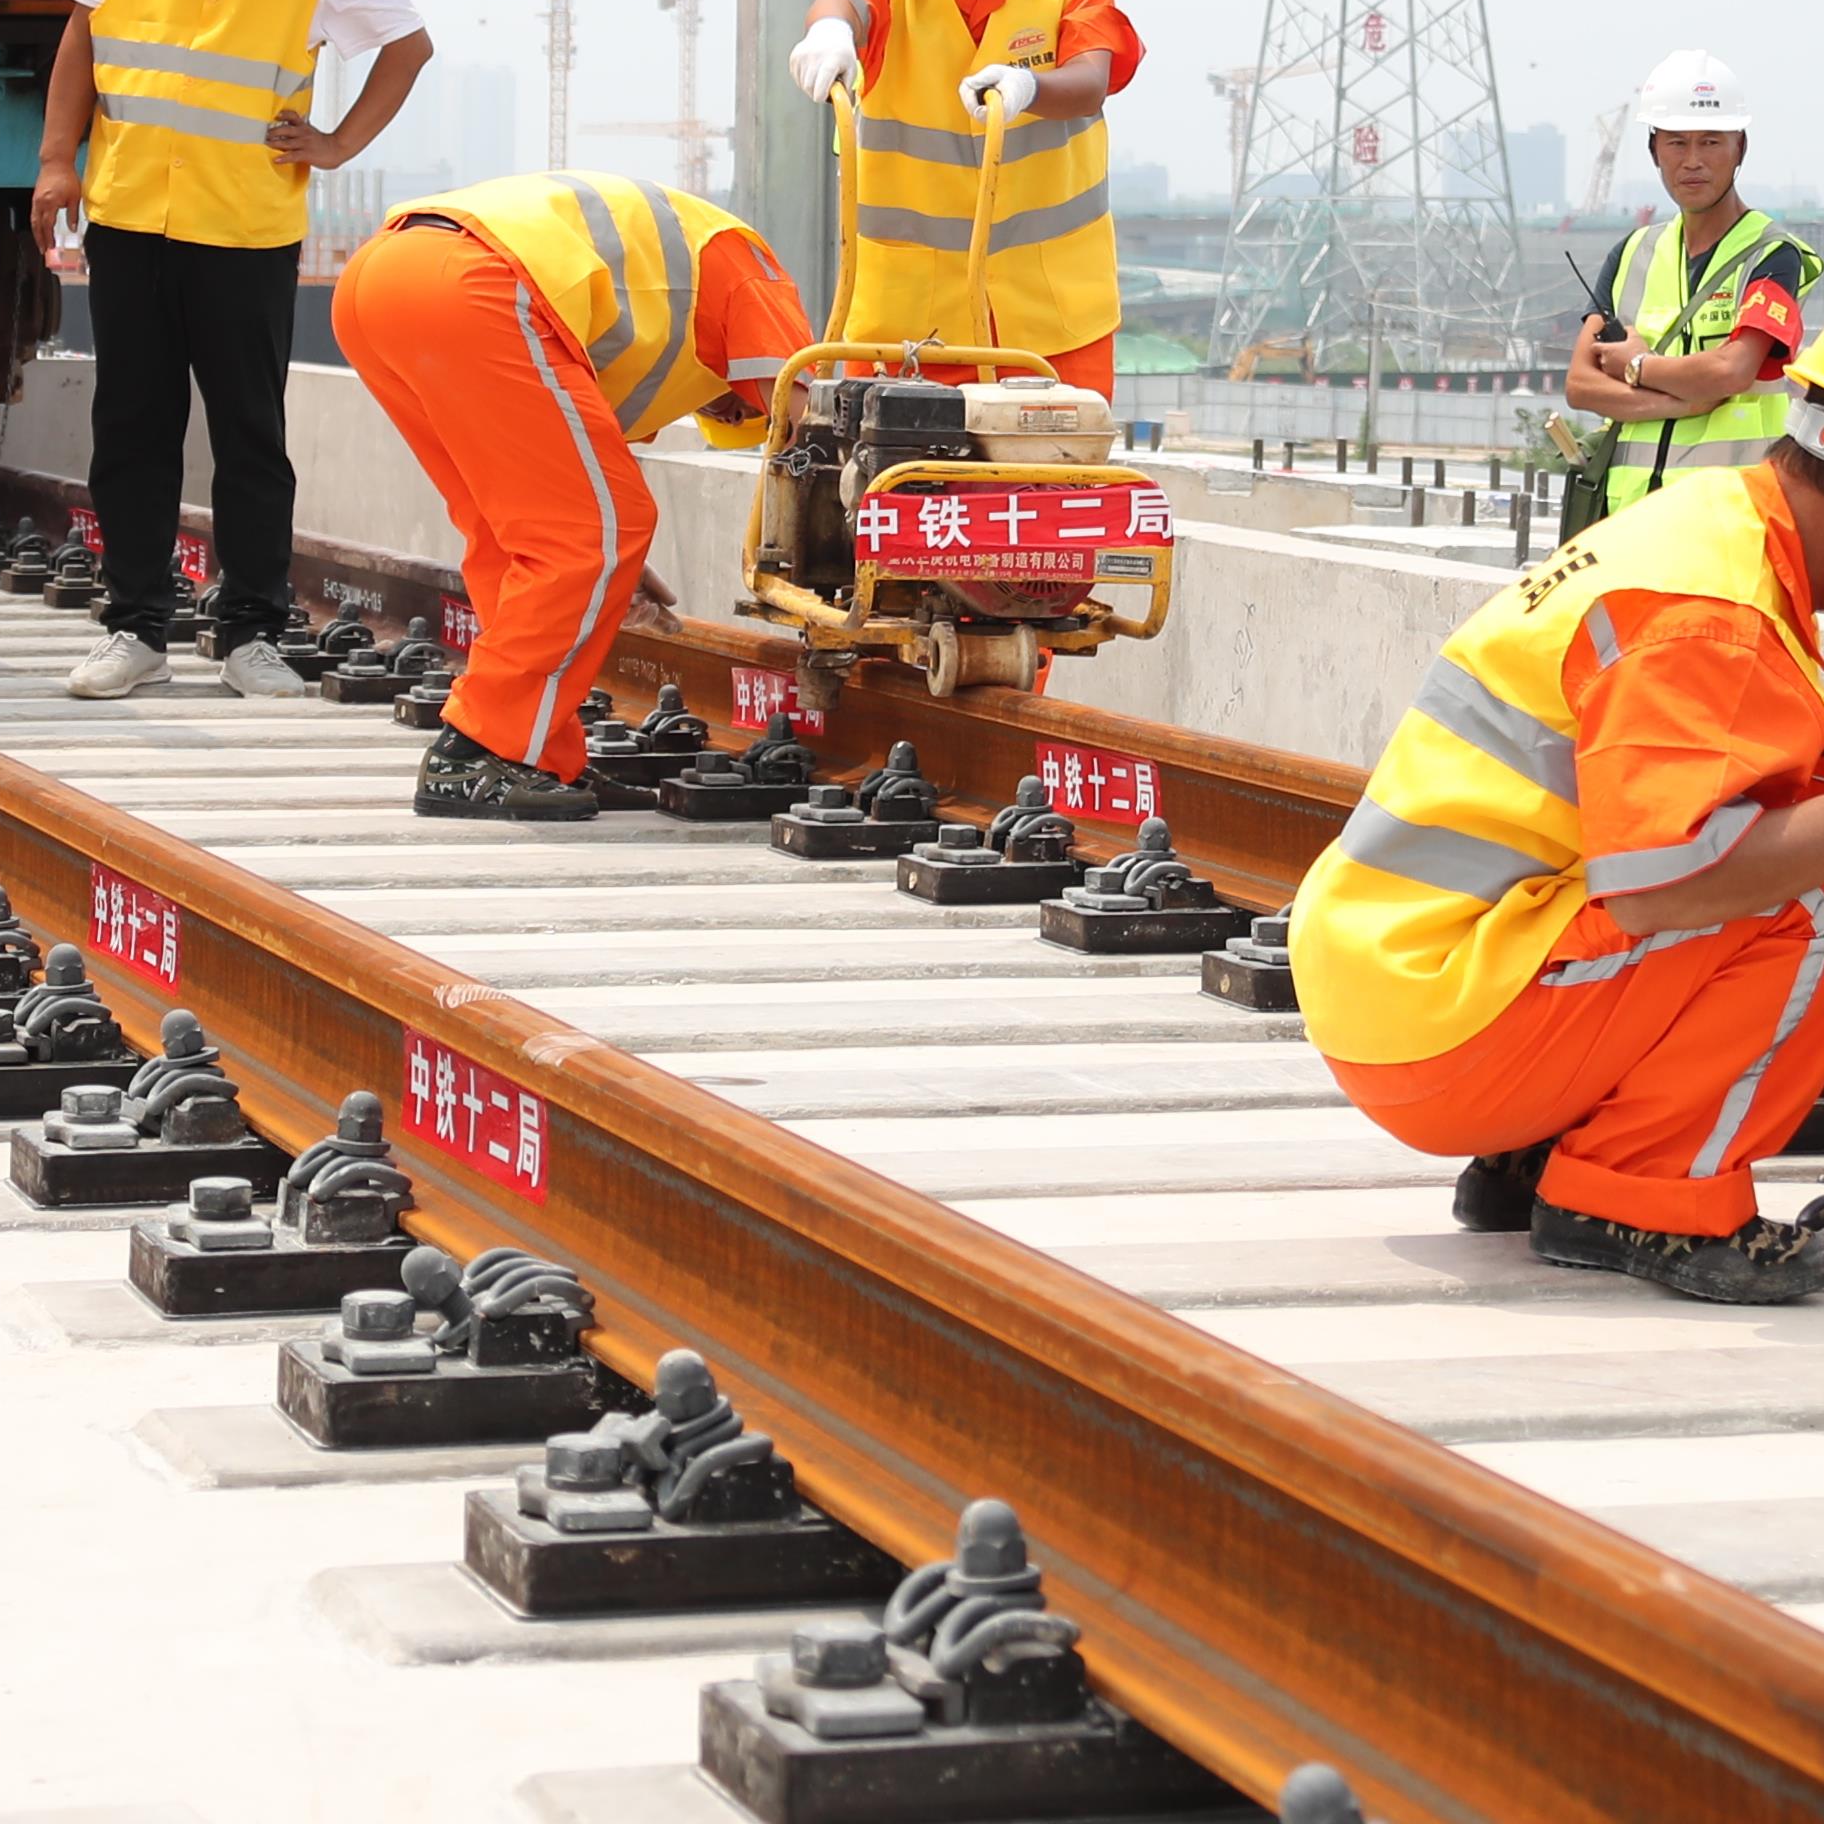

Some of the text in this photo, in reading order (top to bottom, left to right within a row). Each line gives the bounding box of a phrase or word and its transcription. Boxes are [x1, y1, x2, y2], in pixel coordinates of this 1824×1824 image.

[857, 488, 1173, 553] 中铁十二局
[1042, 750, 1155, 819] 中铁十二局
[92, 871, 179, 982] 中铁十二局
[408, 1031, 544, 1187] 中铁十二局
